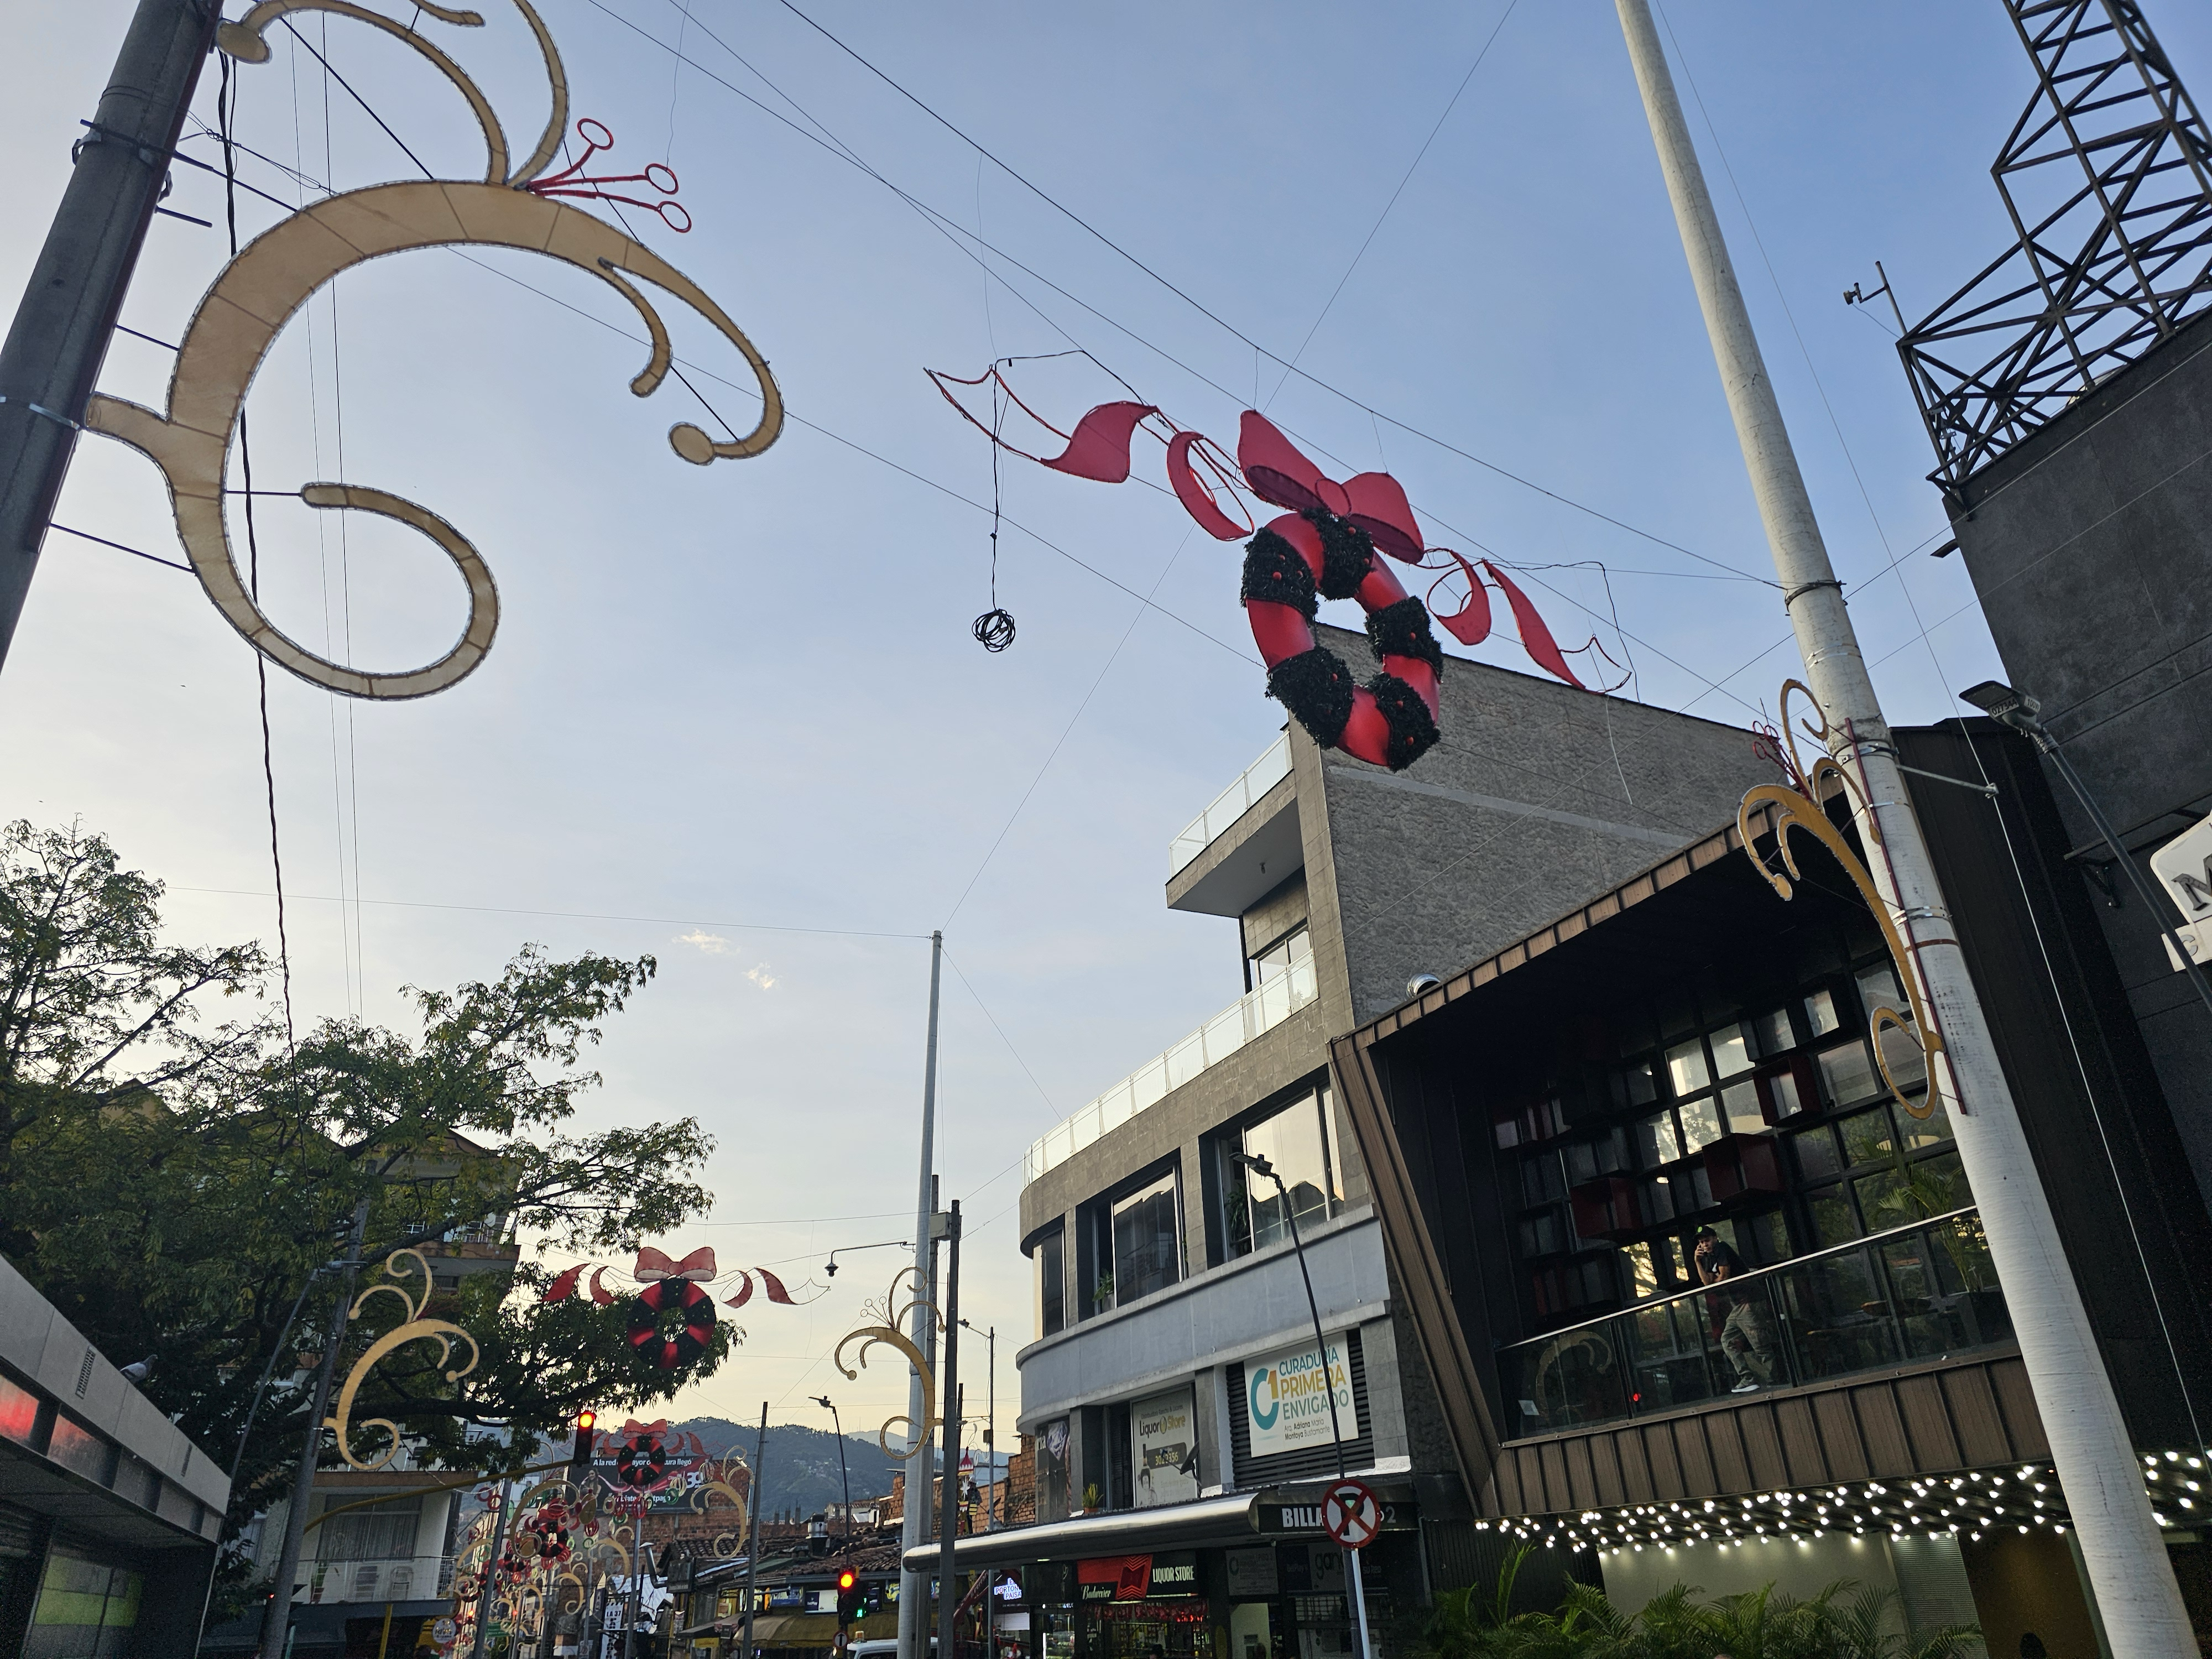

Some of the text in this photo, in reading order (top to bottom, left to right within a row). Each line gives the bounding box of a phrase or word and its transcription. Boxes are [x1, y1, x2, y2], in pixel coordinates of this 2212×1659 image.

[1280, 1364, 1347, 1400] PRIMERA
[1139, 1415, 1186, 1438] Liquor Store
[1285, 1425, 1331, 1441] Montoya Bustamante
[1293, 1421, 1311, 1430] Adriana
[1152, 1565, 1195, 1584] LIQUOR STORE
[1081, 1585, 1111, 1600] Budweiser
